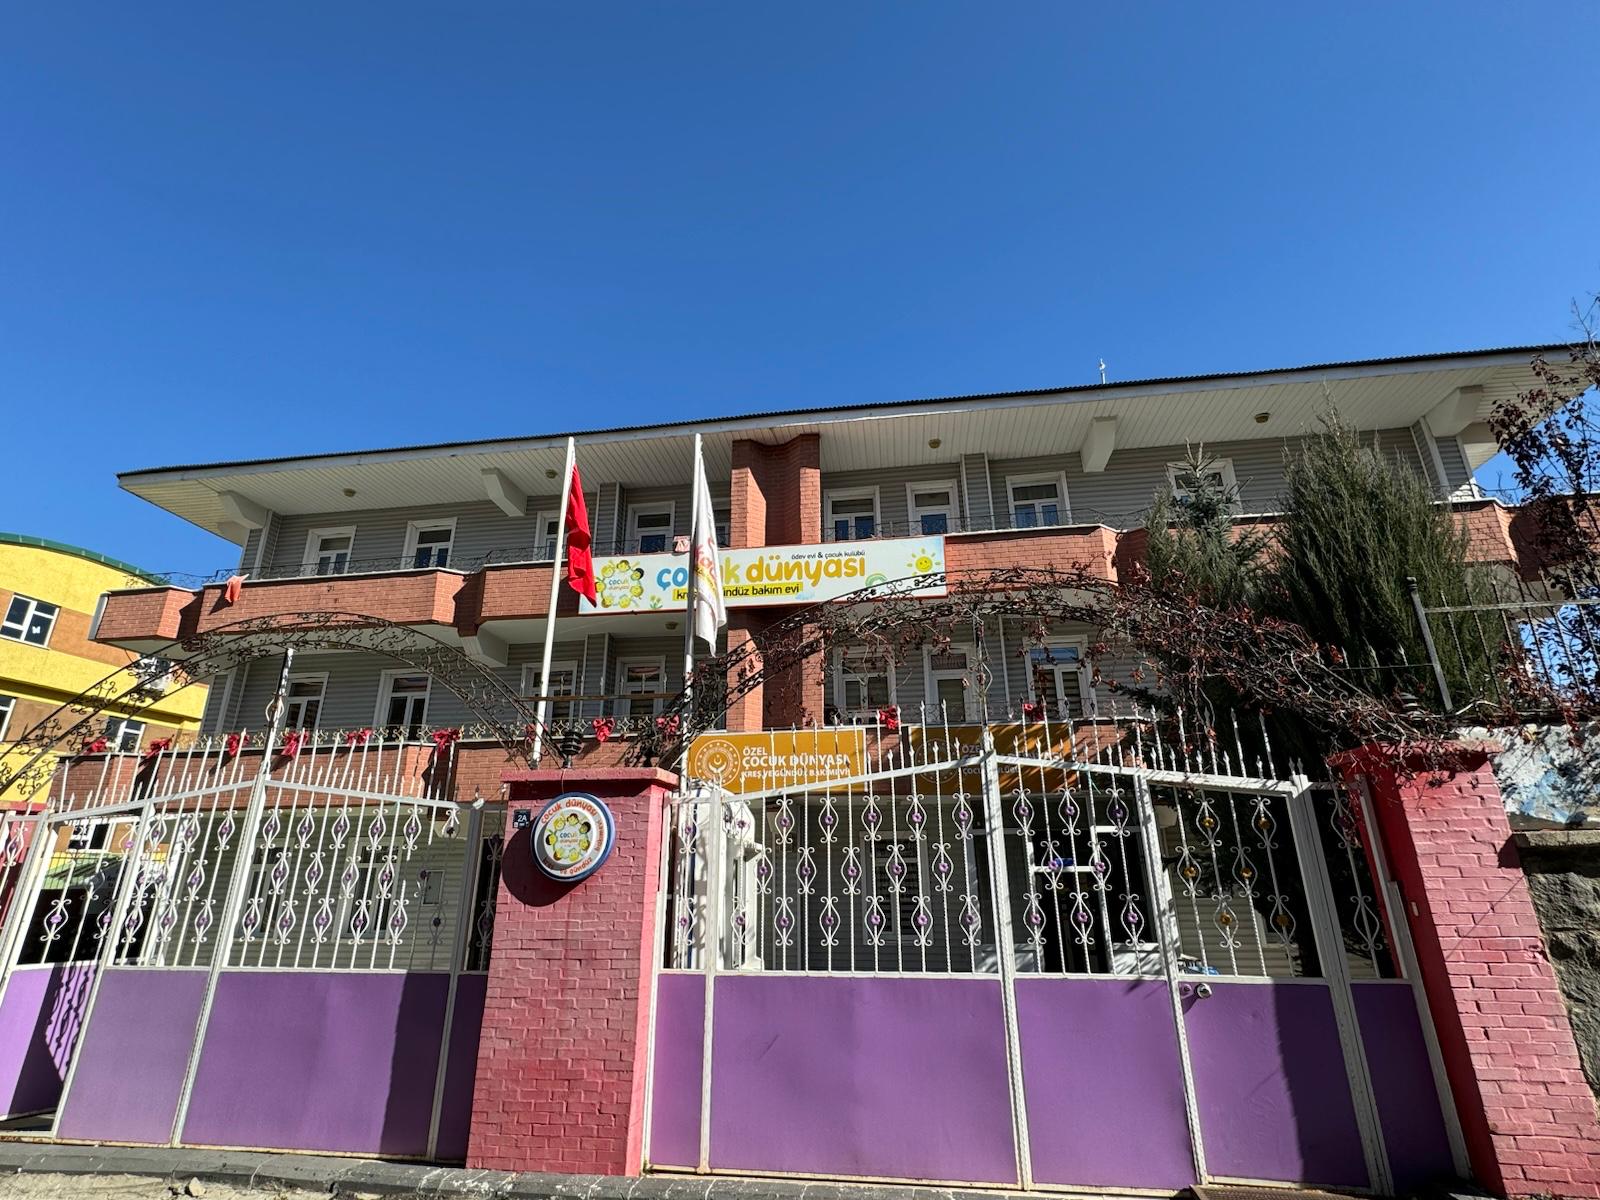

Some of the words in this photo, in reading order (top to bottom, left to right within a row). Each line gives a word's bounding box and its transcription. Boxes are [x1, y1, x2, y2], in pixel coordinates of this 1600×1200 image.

[817, 551, 824, 559] &
[656, 556, 740, 591] çok
[745, 554, 866, 588] dünyası
[723, 586, 749, 597] ndüz
[752, 586, 783, 596] bakım
[785, 583, 800, 594] evi
[743, 746, 768, 756] ÖZEL
[962, 744, 981, 754] ÖZE
[742, 755, 787, 770] ÇOCUK
[517, 814, 527, 822] 2A
